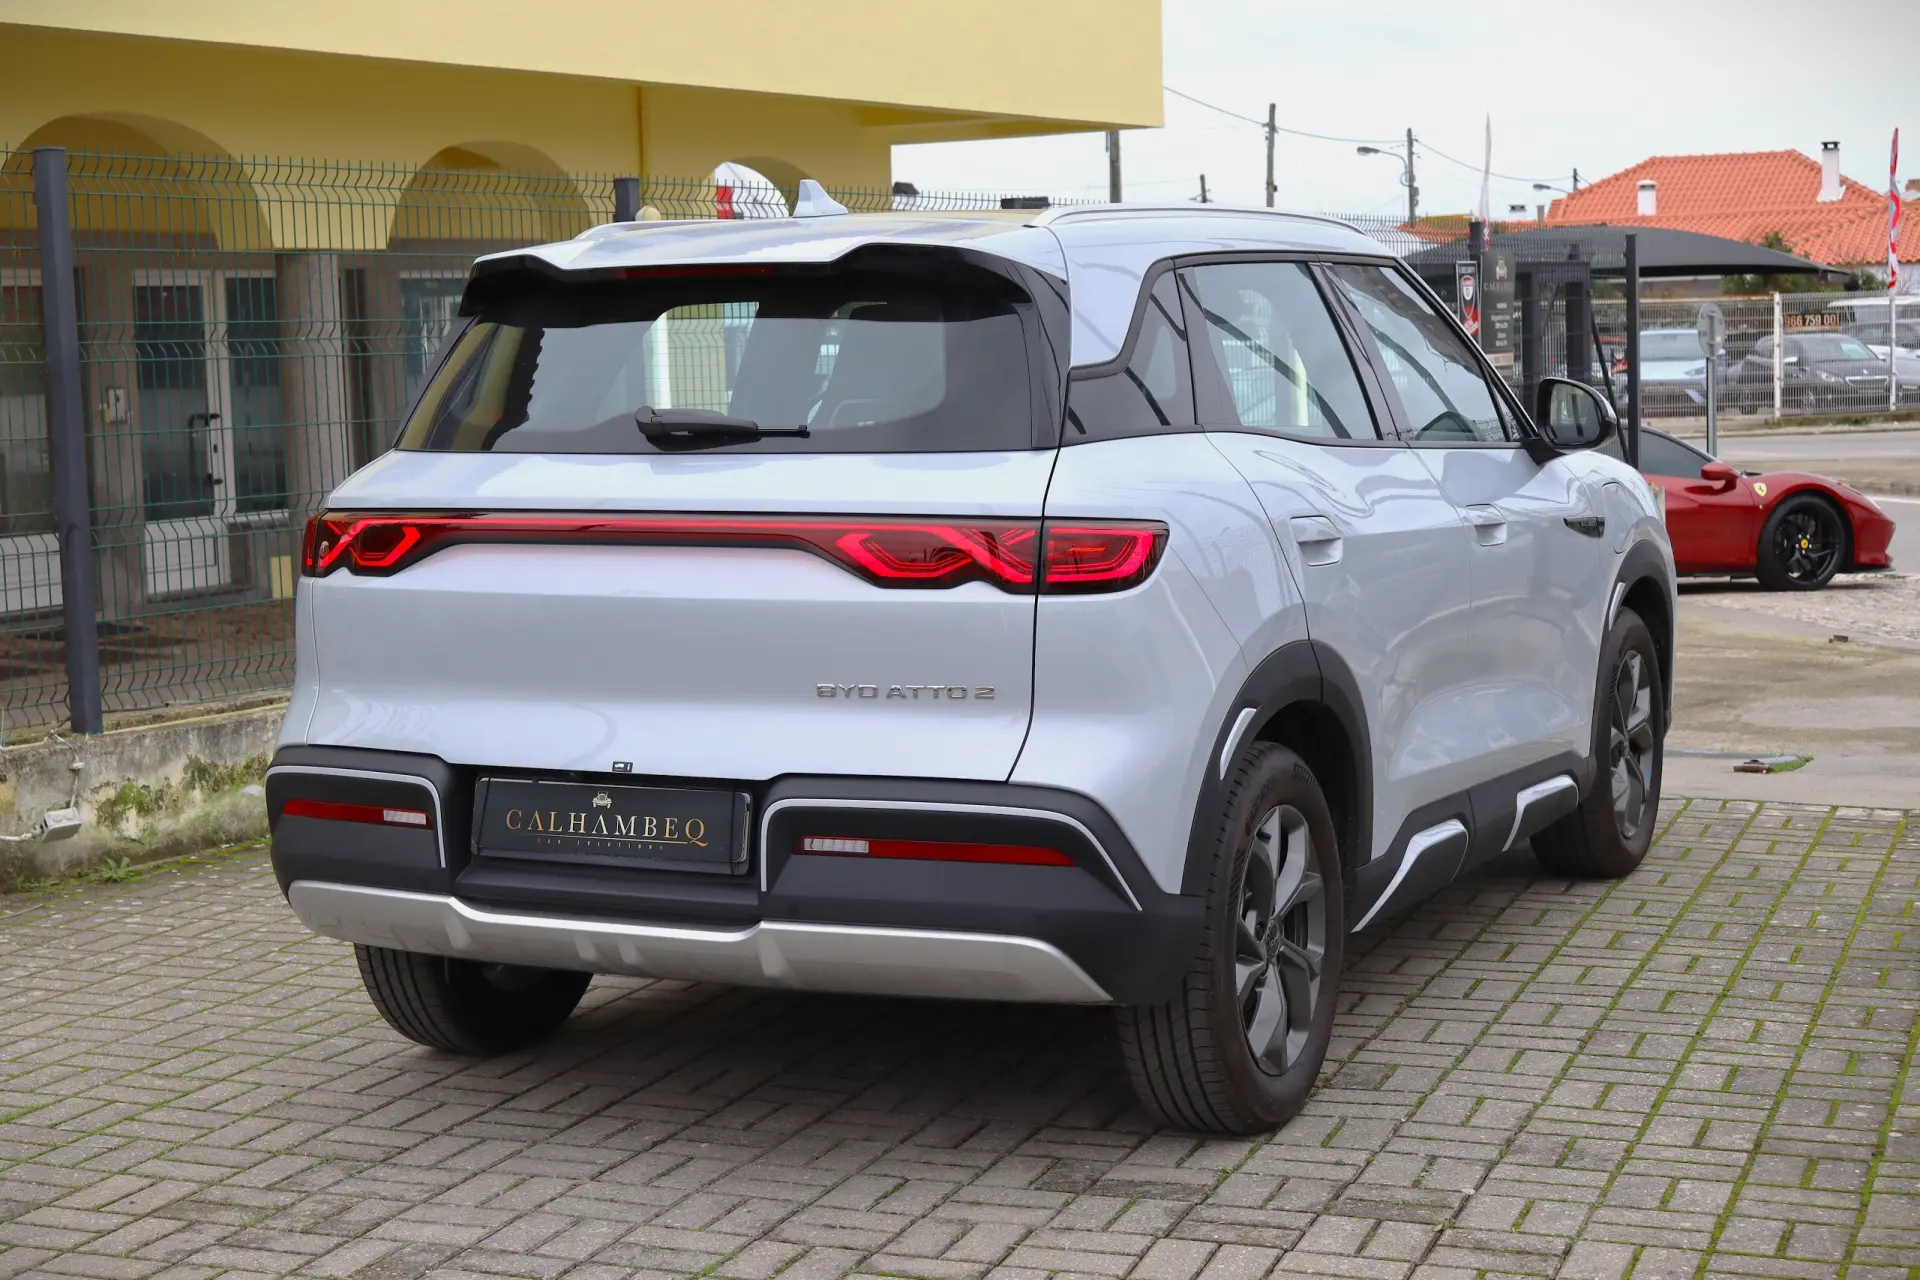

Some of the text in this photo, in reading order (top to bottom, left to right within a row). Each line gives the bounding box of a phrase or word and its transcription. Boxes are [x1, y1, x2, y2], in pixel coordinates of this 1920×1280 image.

[1804, 314, 1822, 326] 759
[1823, 314, 1840, 326] 001
[816, 683, 995, 699] BYD ATTO 2
[506, 809, 709, 847] CALHAMBEQ
